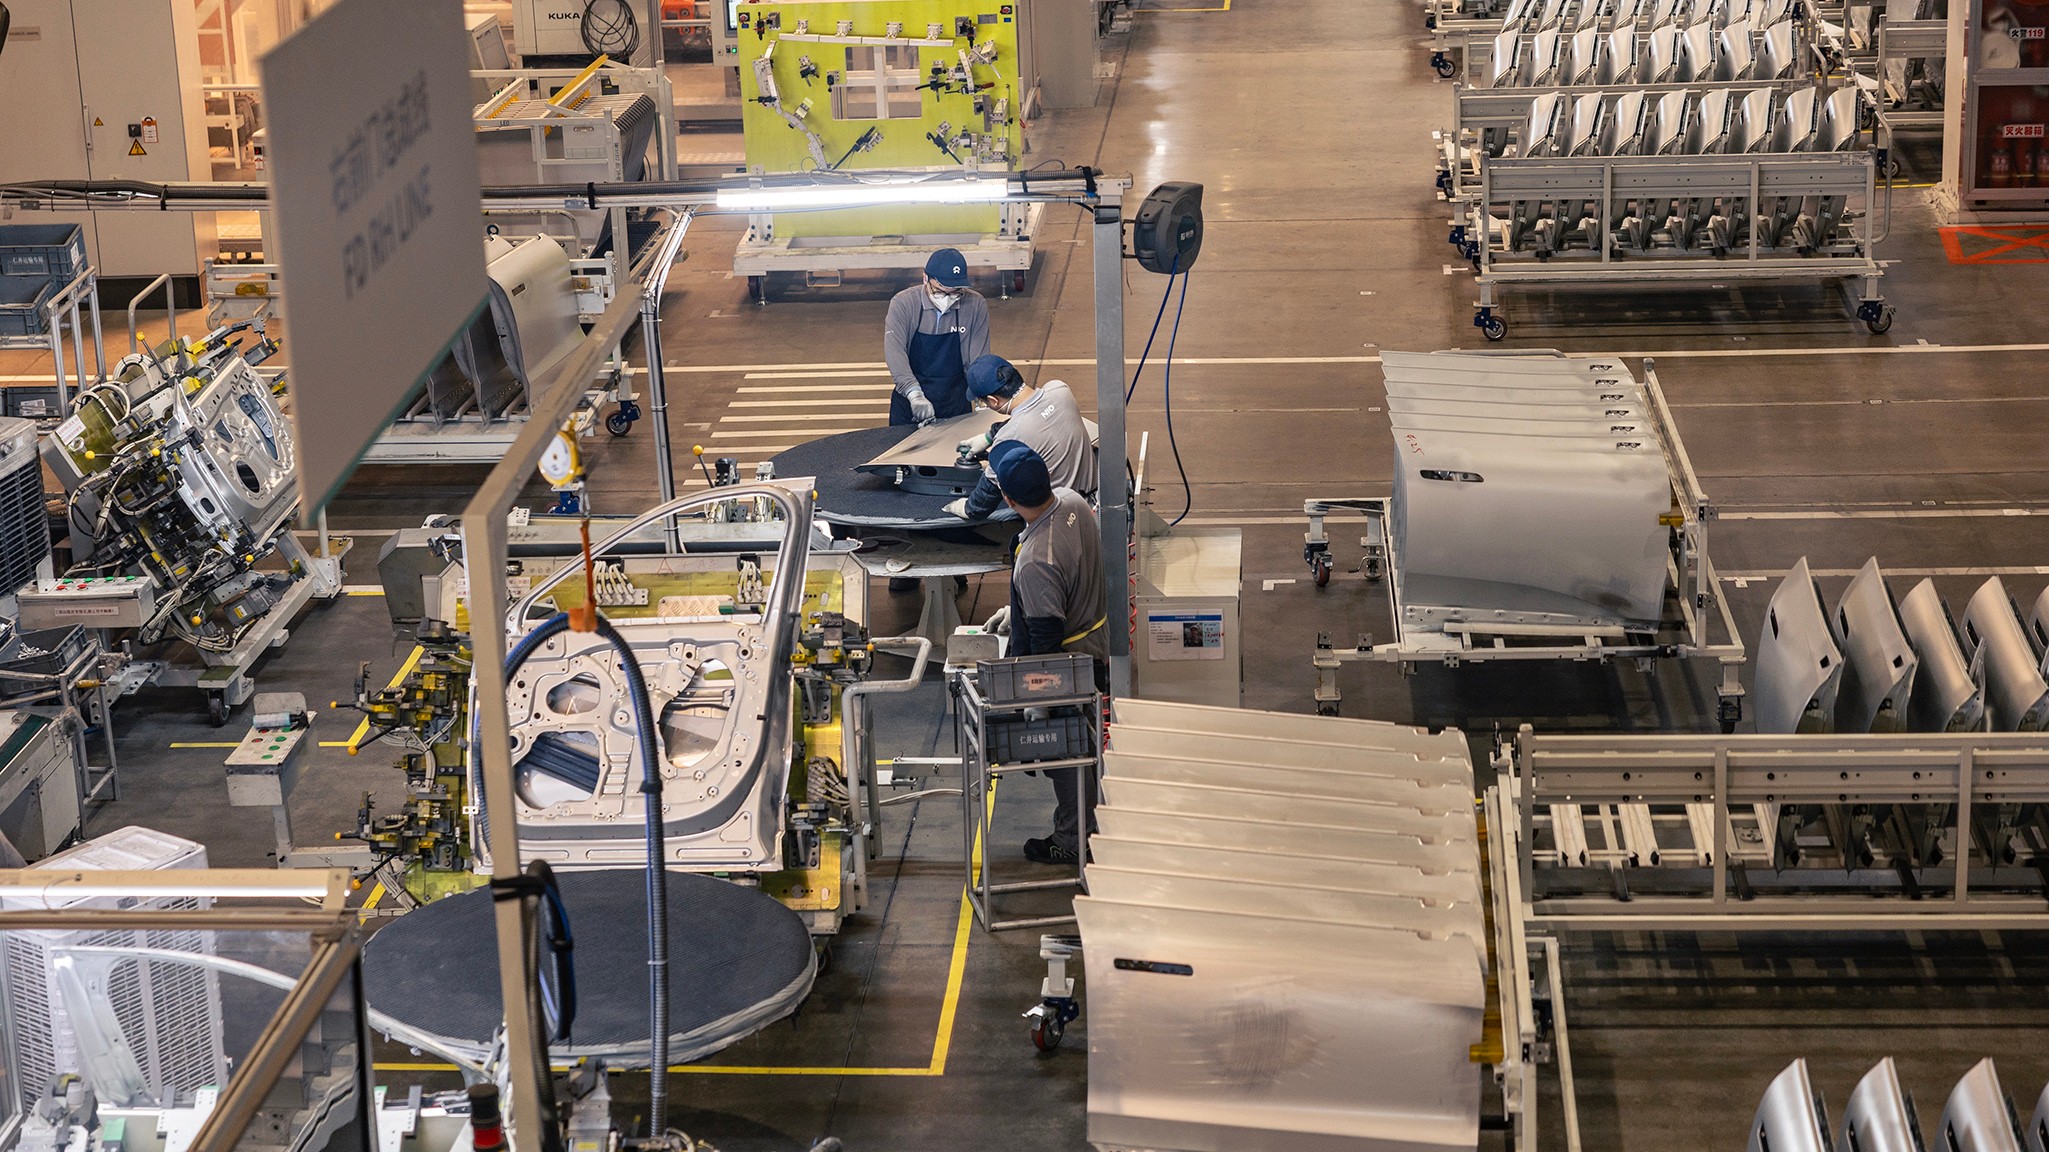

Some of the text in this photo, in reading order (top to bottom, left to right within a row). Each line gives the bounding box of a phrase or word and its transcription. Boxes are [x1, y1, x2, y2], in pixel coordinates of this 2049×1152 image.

[2005, 126, 2043, 136] 灭火器箱
[1041, 405, 1055, 419] NIO
[1066, 512, 1077, 528] NIO
[1020, 733, 1057, 744] 仁井运输专用
